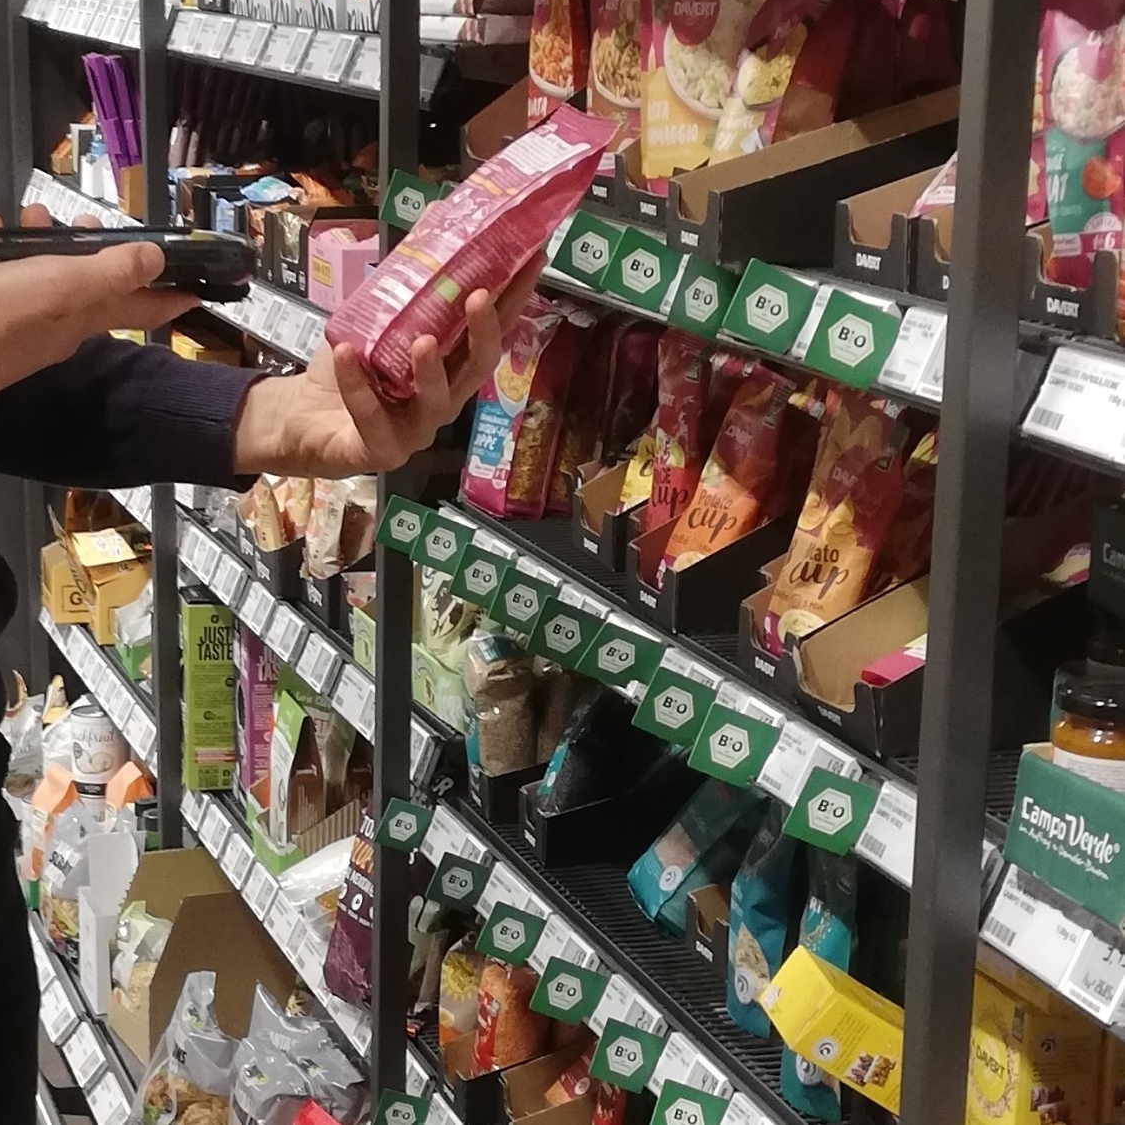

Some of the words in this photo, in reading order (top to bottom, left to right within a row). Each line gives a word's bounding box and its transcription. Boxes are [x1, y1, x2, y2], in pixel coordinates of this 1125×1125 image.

[673, 1, 717, 17] DAVERT
[1046, 297, 1080, 318] DAVERT
[698, 488, 734, 510] Potato
[687, 507, 738, 543] cup
[788, 561, 849, 600] cup
[200, 626, 232, 646] JUST
[197, 643, 233, 661] TASTE
[1021, 796, 1067, 841] Campo
[1065, 813, 1114, 865] Verde
[974, 1044, 1006, 1079] DAVERT
